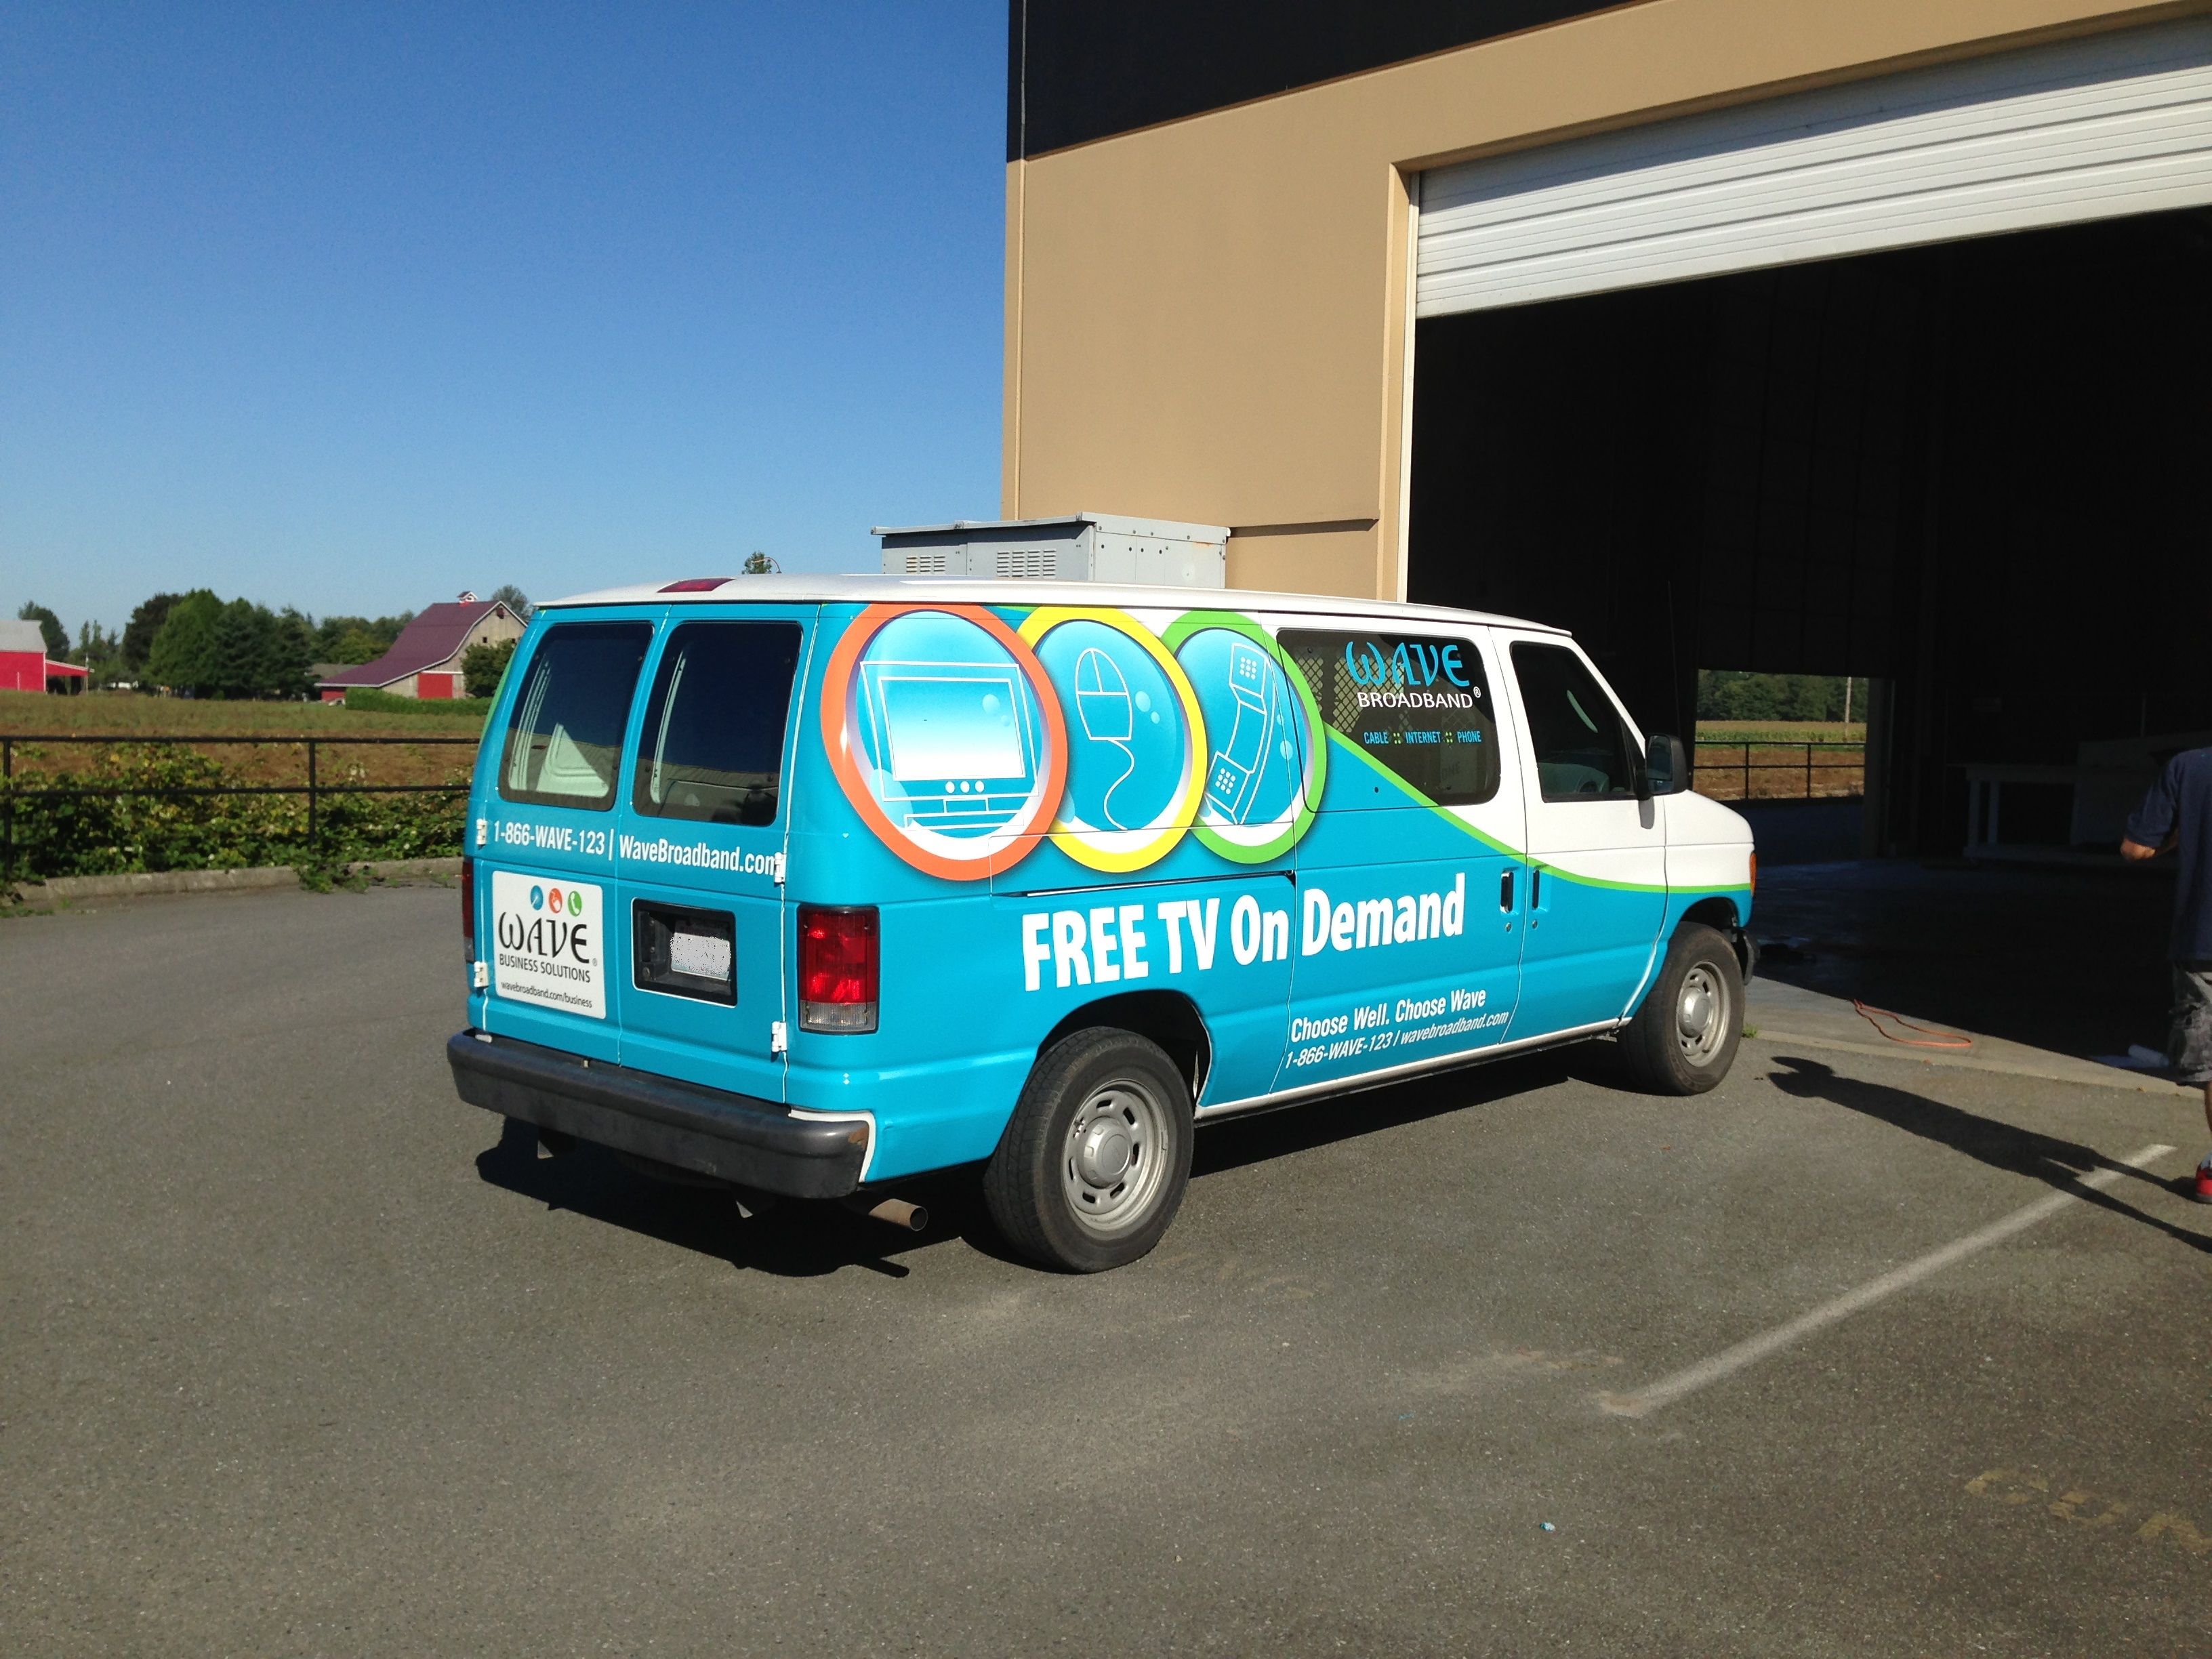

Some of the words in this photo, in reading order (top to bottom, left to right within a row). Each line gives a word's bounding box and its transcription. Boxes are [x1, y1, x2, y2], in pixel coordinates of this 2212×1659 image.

[1345, 641, 1469, 687] WAVE
[1357, 691, 1473, 709] BROADBAND
[1364, 731, 1389, 744] CABLE
[1405, 731, 1441, 743] INTERNET
[1457, 731, 1481, 743] PHONE
[494, 821, 605, 856] 1-866-WAVE-123
[498, 912, 590, 964] WAVE
[1022, 904, 1149, 992] FREE
[1158, 898, 1220, 974] TV
[1231, 895, 1290, 966] On
[1301, 872, 1465, 957] Demand
[499, 954, 538, 972] BUSINESS
[541, 961, 590, 983] SOLUTIONS
[1291, 1014, 1348, 1043] Choose
[1354, 1003, 1390, 1031] Well.
[1395, 996, 1446, 1023] Choose
[1450, 989, 1486, 1012] Wave
[1286, 1033, 1391, 1069] 1-866-WAVE-123
[1400, 1011, 1509, 1045] wavebroadband.com
